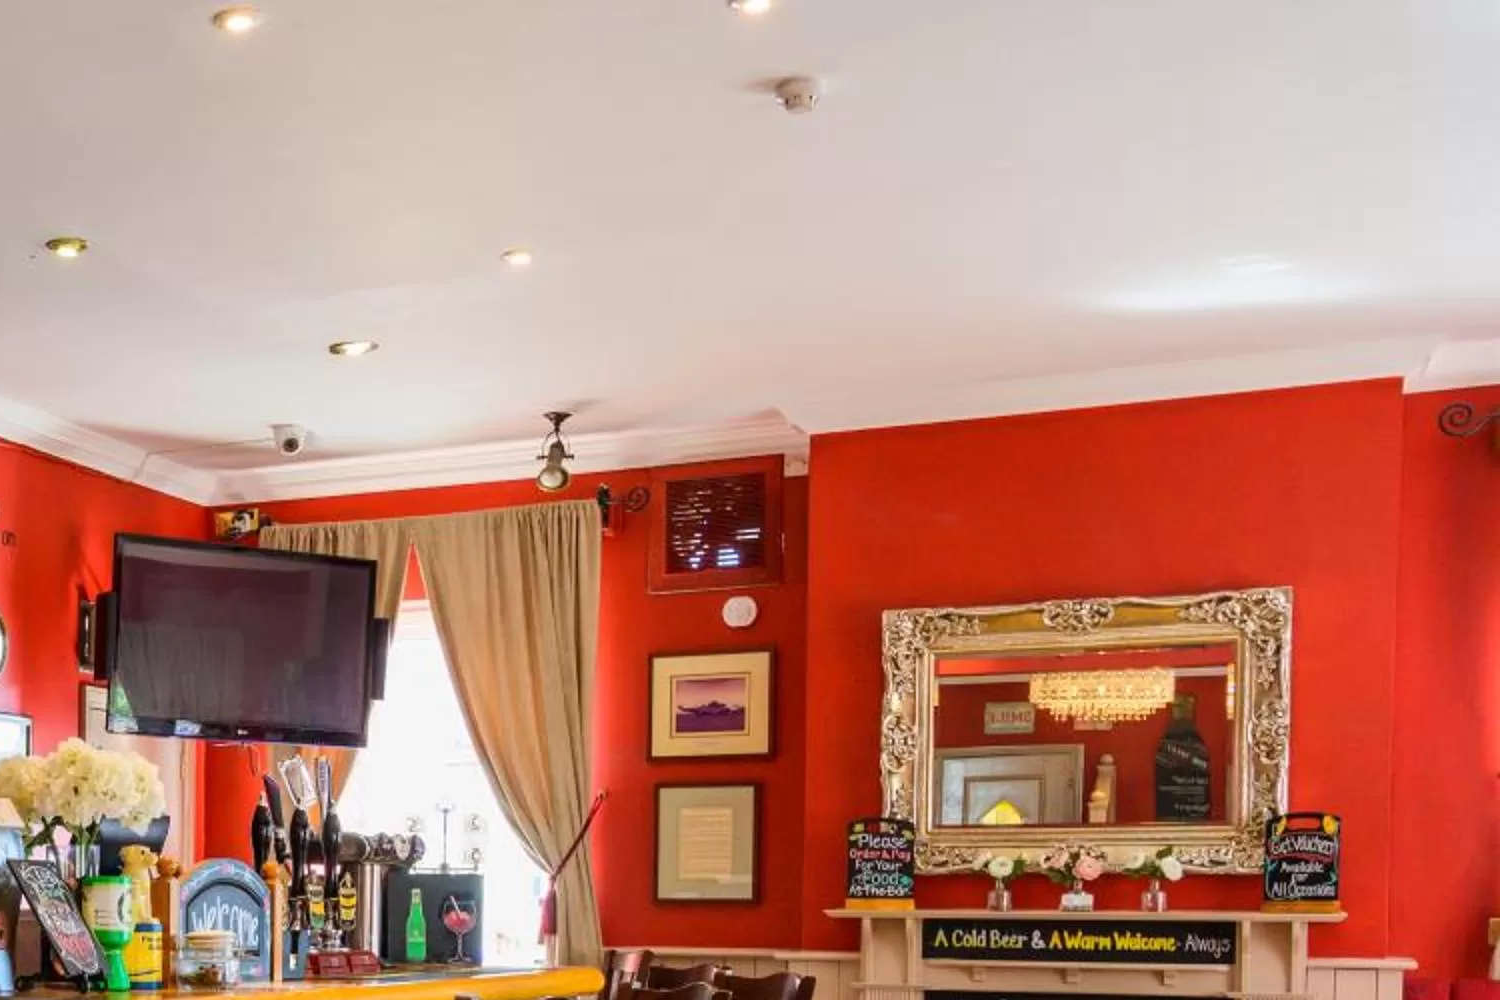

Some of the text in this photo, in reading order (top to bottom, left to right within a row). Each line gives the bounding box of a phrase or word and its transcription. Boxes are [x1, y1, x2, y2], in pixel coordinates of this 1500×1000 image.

[1, 530, 17, 547] on
[858, 833, 908, 849] Please
[875, 859, 903, 872] Your
[862, 870, 900, 885] Food
[1271, 881, 1287, 898] All
[934, 929, 1231, 958] A Cold Beer & A Warm Welcome Always
